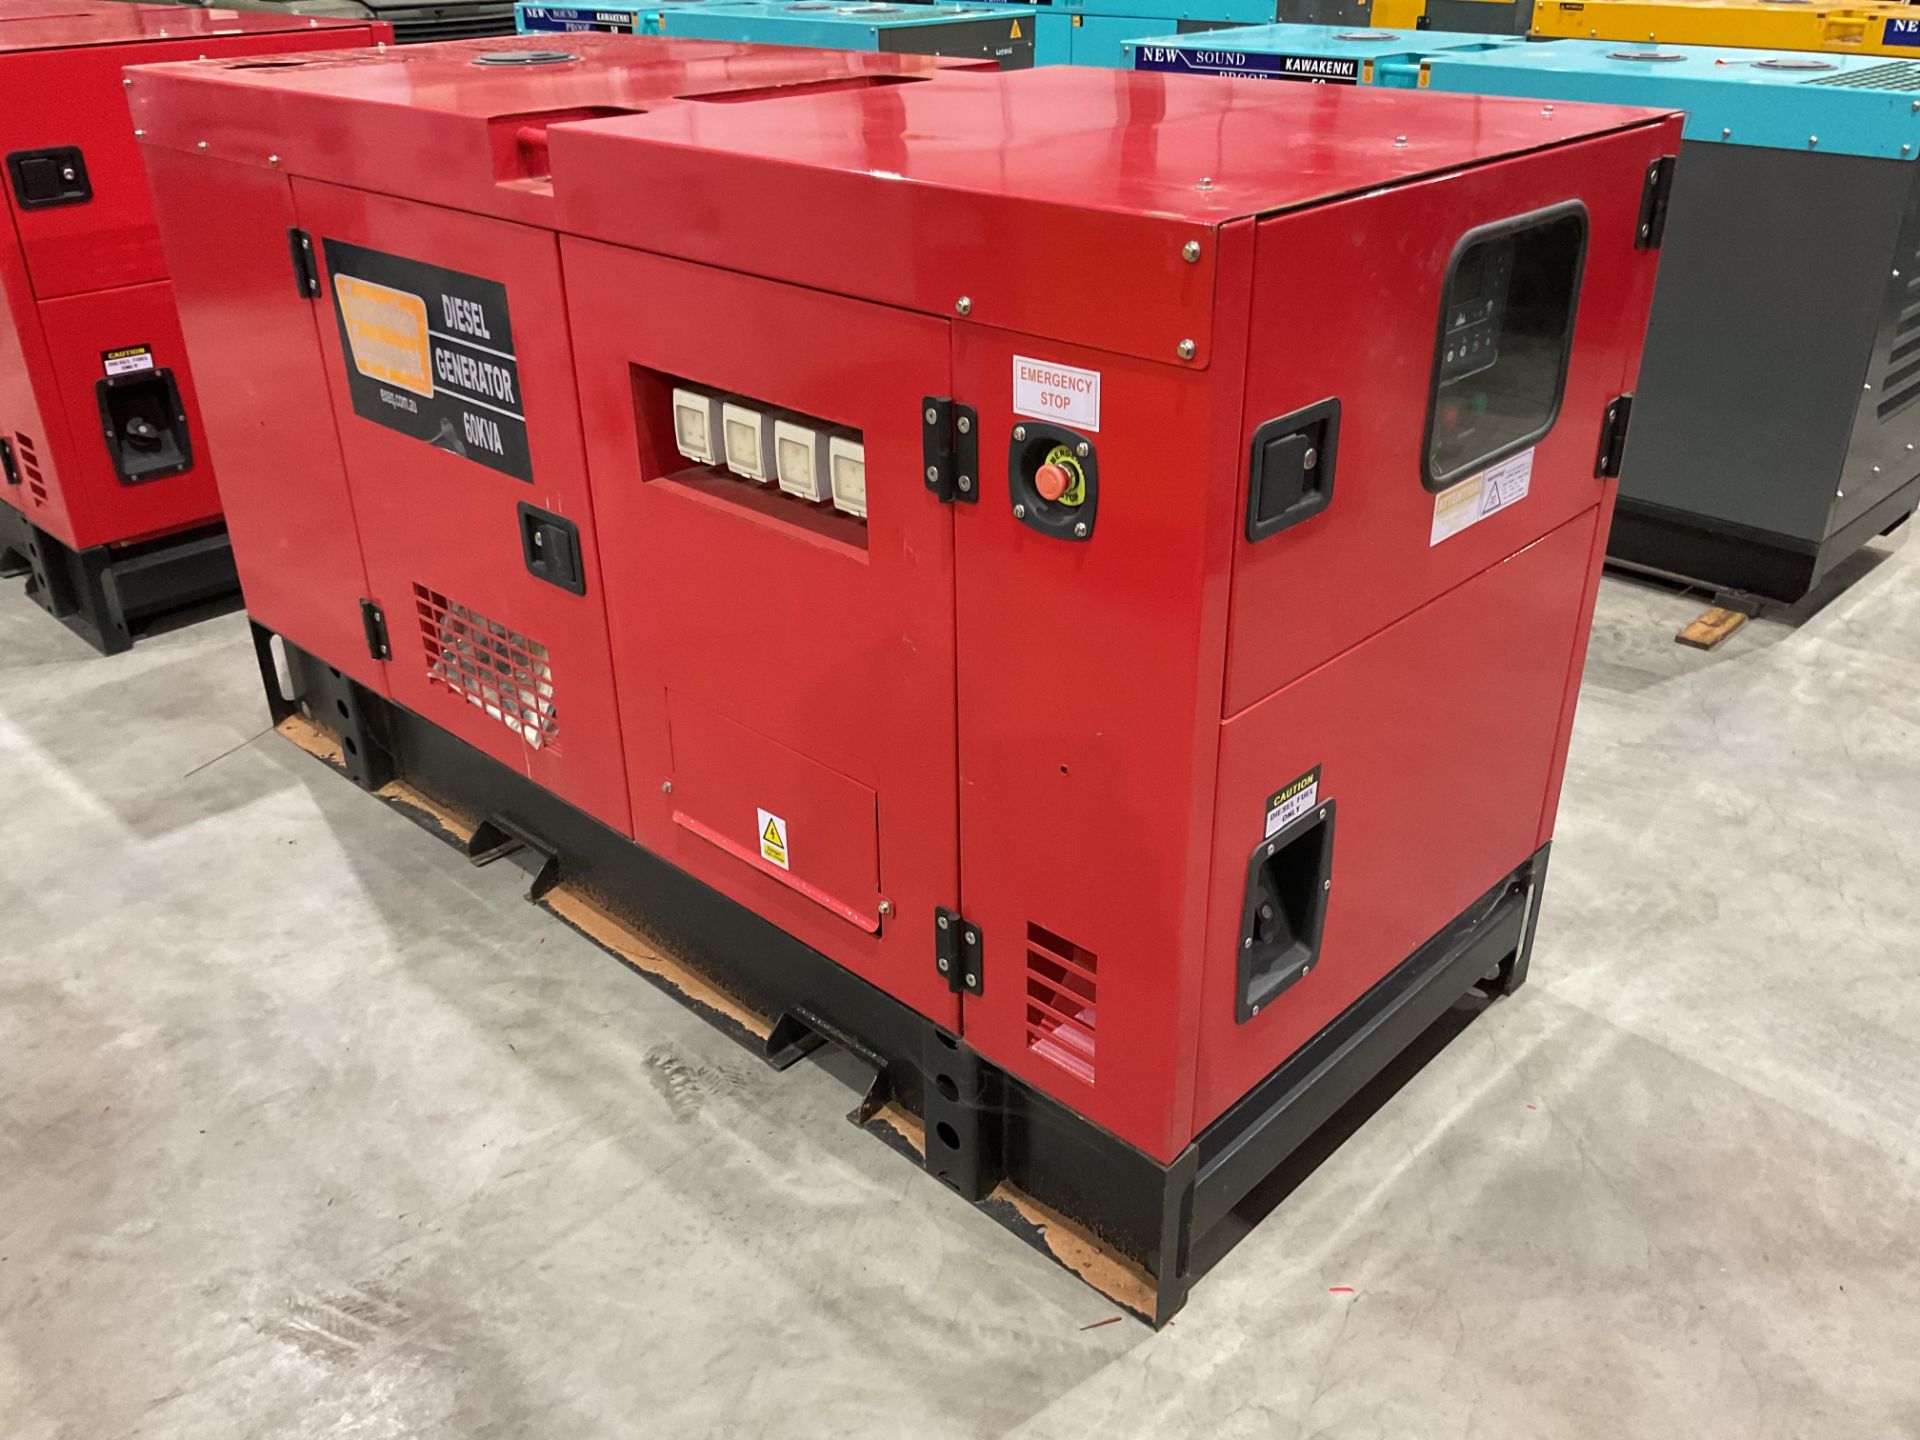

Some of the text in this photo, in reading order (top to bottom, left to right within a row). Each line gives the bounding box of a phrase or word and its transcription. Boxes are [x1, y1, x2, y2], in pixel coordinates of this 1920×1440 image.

[526, 7, 578, 19] NEW SOUND
[1143, 47, 1245, 66] NEW SOUND
[1285, 57, 1354, 76] KAWAKENKI
[442, 293, 490, 340] DIESEL
[435, 347, 515, 404] GENERATOR
[1020, 366, 1093, 394] EMERGENCY
[1041, 391, 1071, 410] STOP
[463, 412, 504, 456] 60KVA
[1273, 773, 1314, 807] CAUTION
[1282, 804, 1301, 822] ONLY
